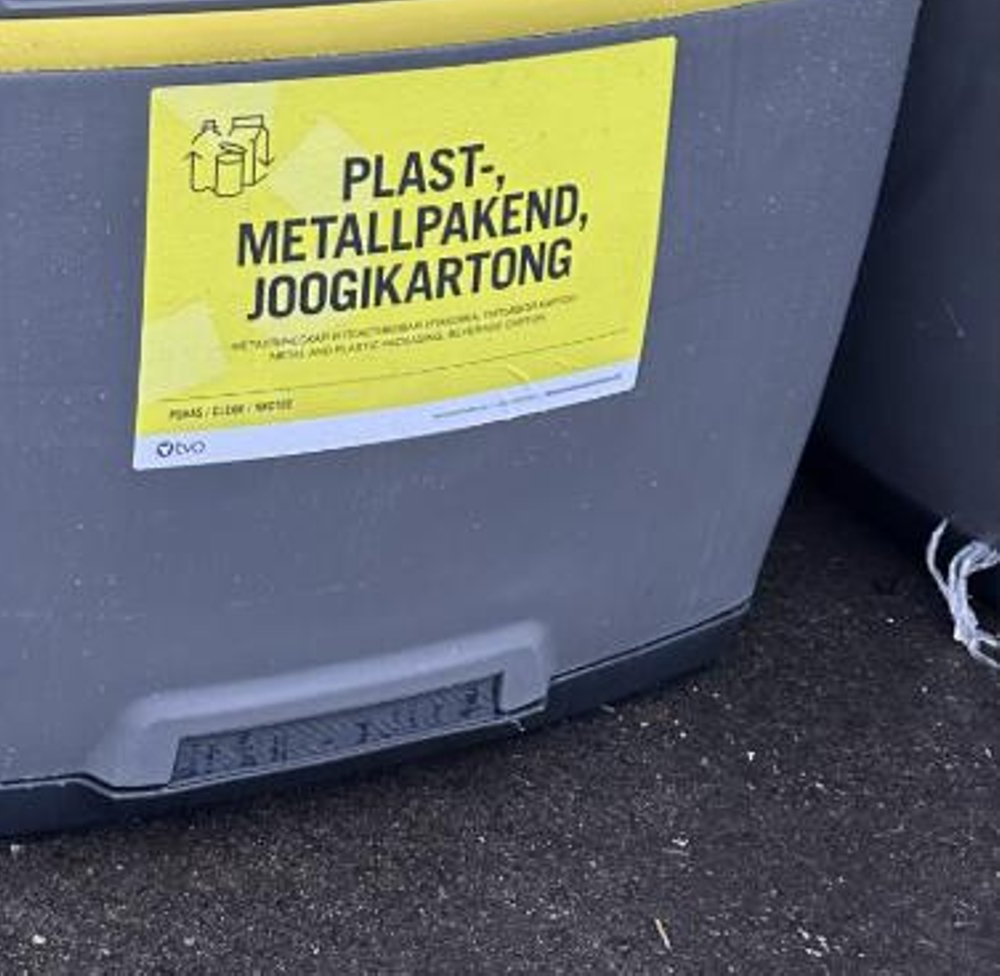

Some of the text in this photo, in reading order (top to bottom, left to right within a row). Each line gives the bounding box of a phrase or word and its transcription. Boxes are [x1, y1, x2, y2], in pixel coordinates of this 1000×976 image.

[341, 143, 505, 202] PLAST-,
[236, 183, 588, 267] METALLPAKEND,
[247, 237, 572, 321] JOOGIKARTONG
